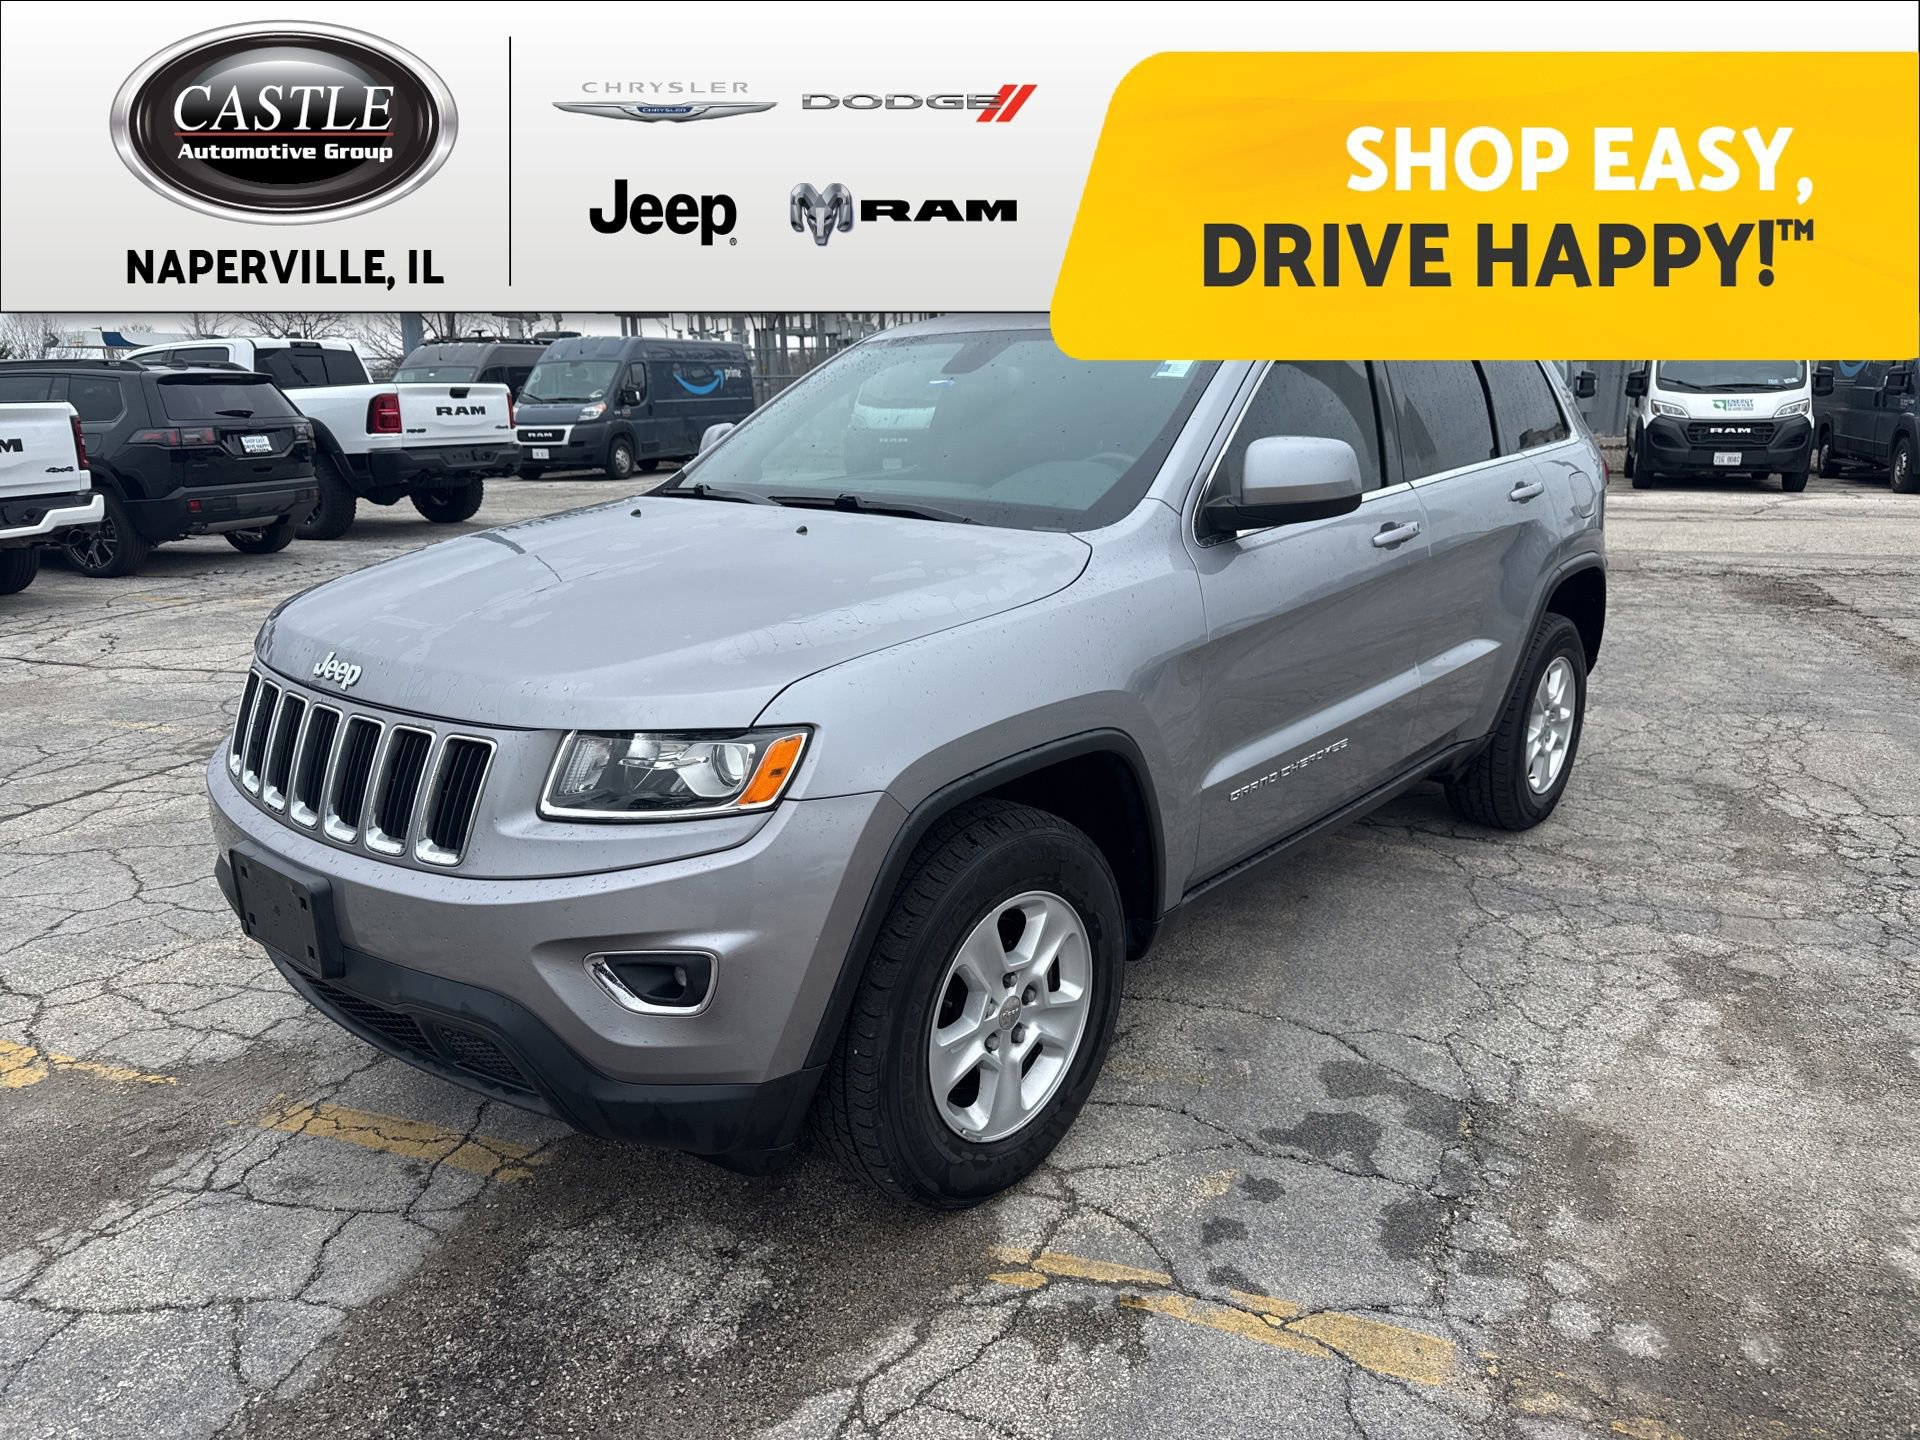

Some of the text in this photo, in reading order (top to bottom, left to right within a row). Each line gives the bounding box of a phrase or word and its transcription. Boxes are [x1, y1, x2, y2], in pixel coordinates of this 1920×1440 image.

[436, 406, 486, 416] RAM
[313, 651, 363, 691] Jeep
[1229, 738, 1348, 801] GRAND CHEROKEE
